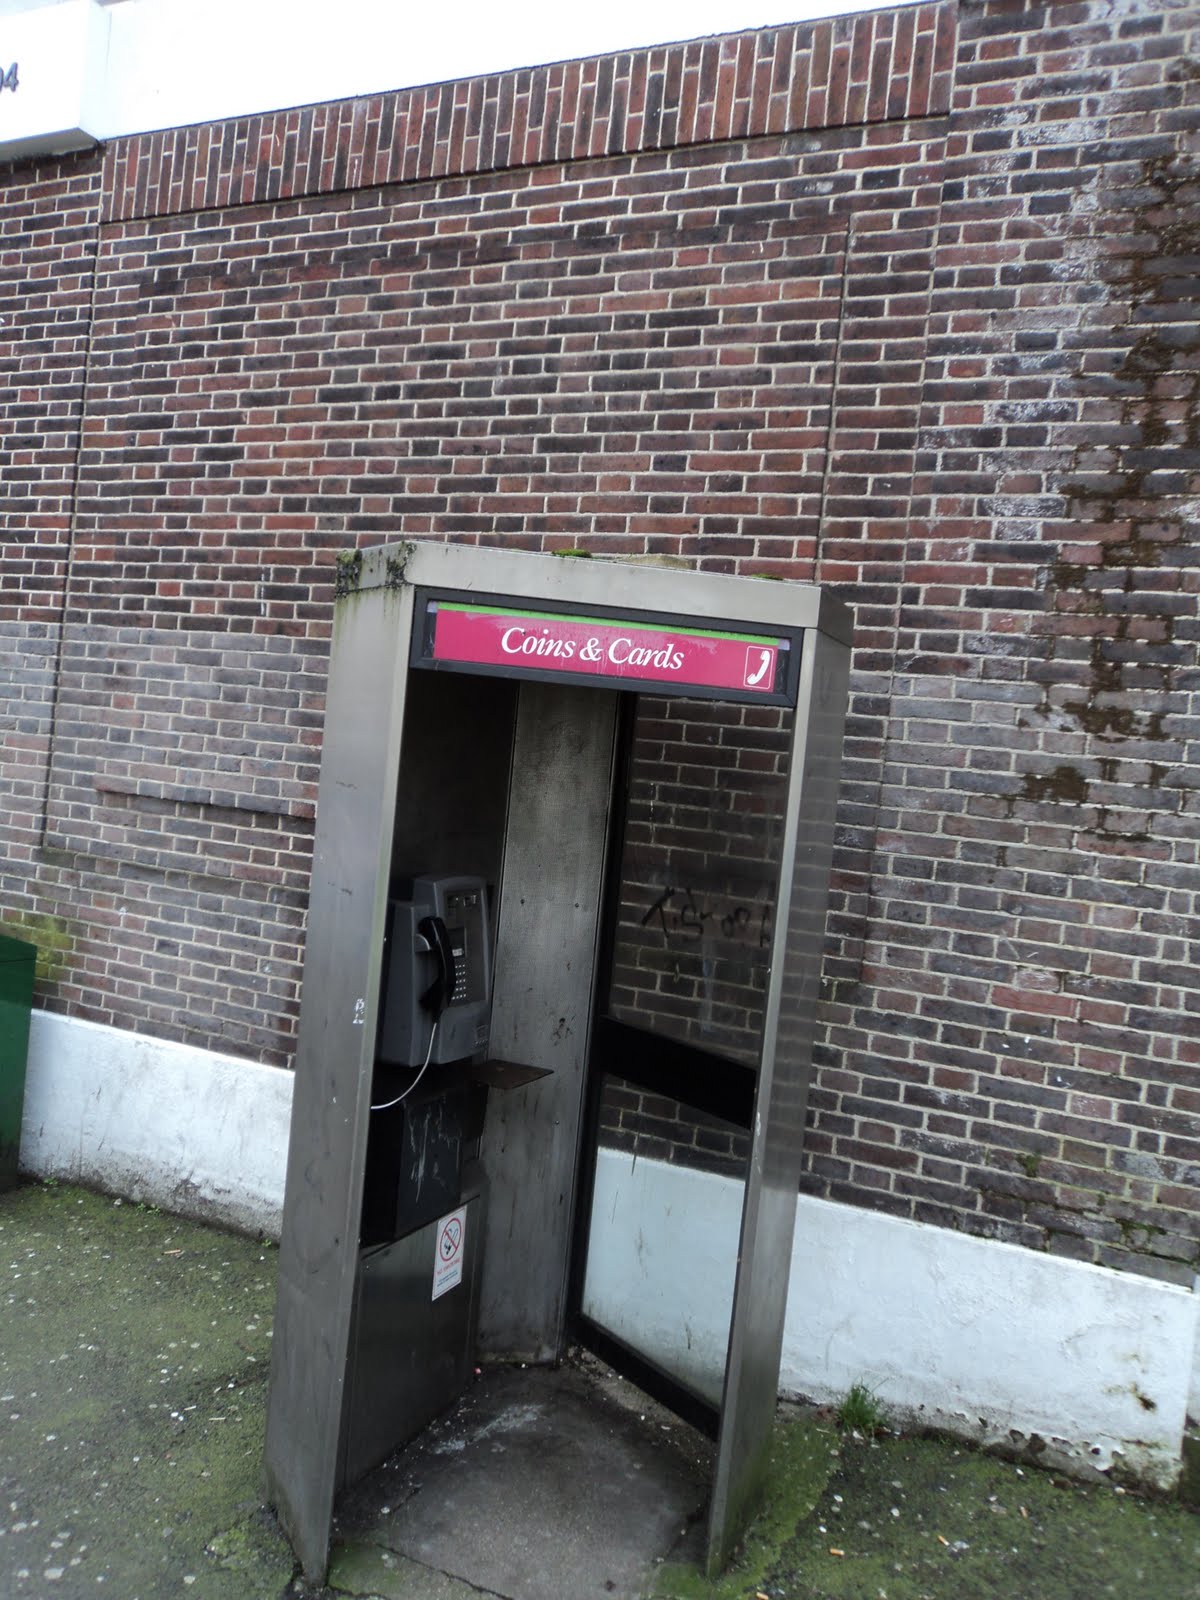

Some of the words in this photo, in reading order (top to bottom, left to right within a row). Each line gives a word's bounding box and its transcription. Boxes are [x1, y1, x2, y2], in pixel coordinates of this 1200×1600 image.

[501, 627, 576, 658] Coins
[579, 637, 603, 662] &
[608, 638, 685, 670] Cards
